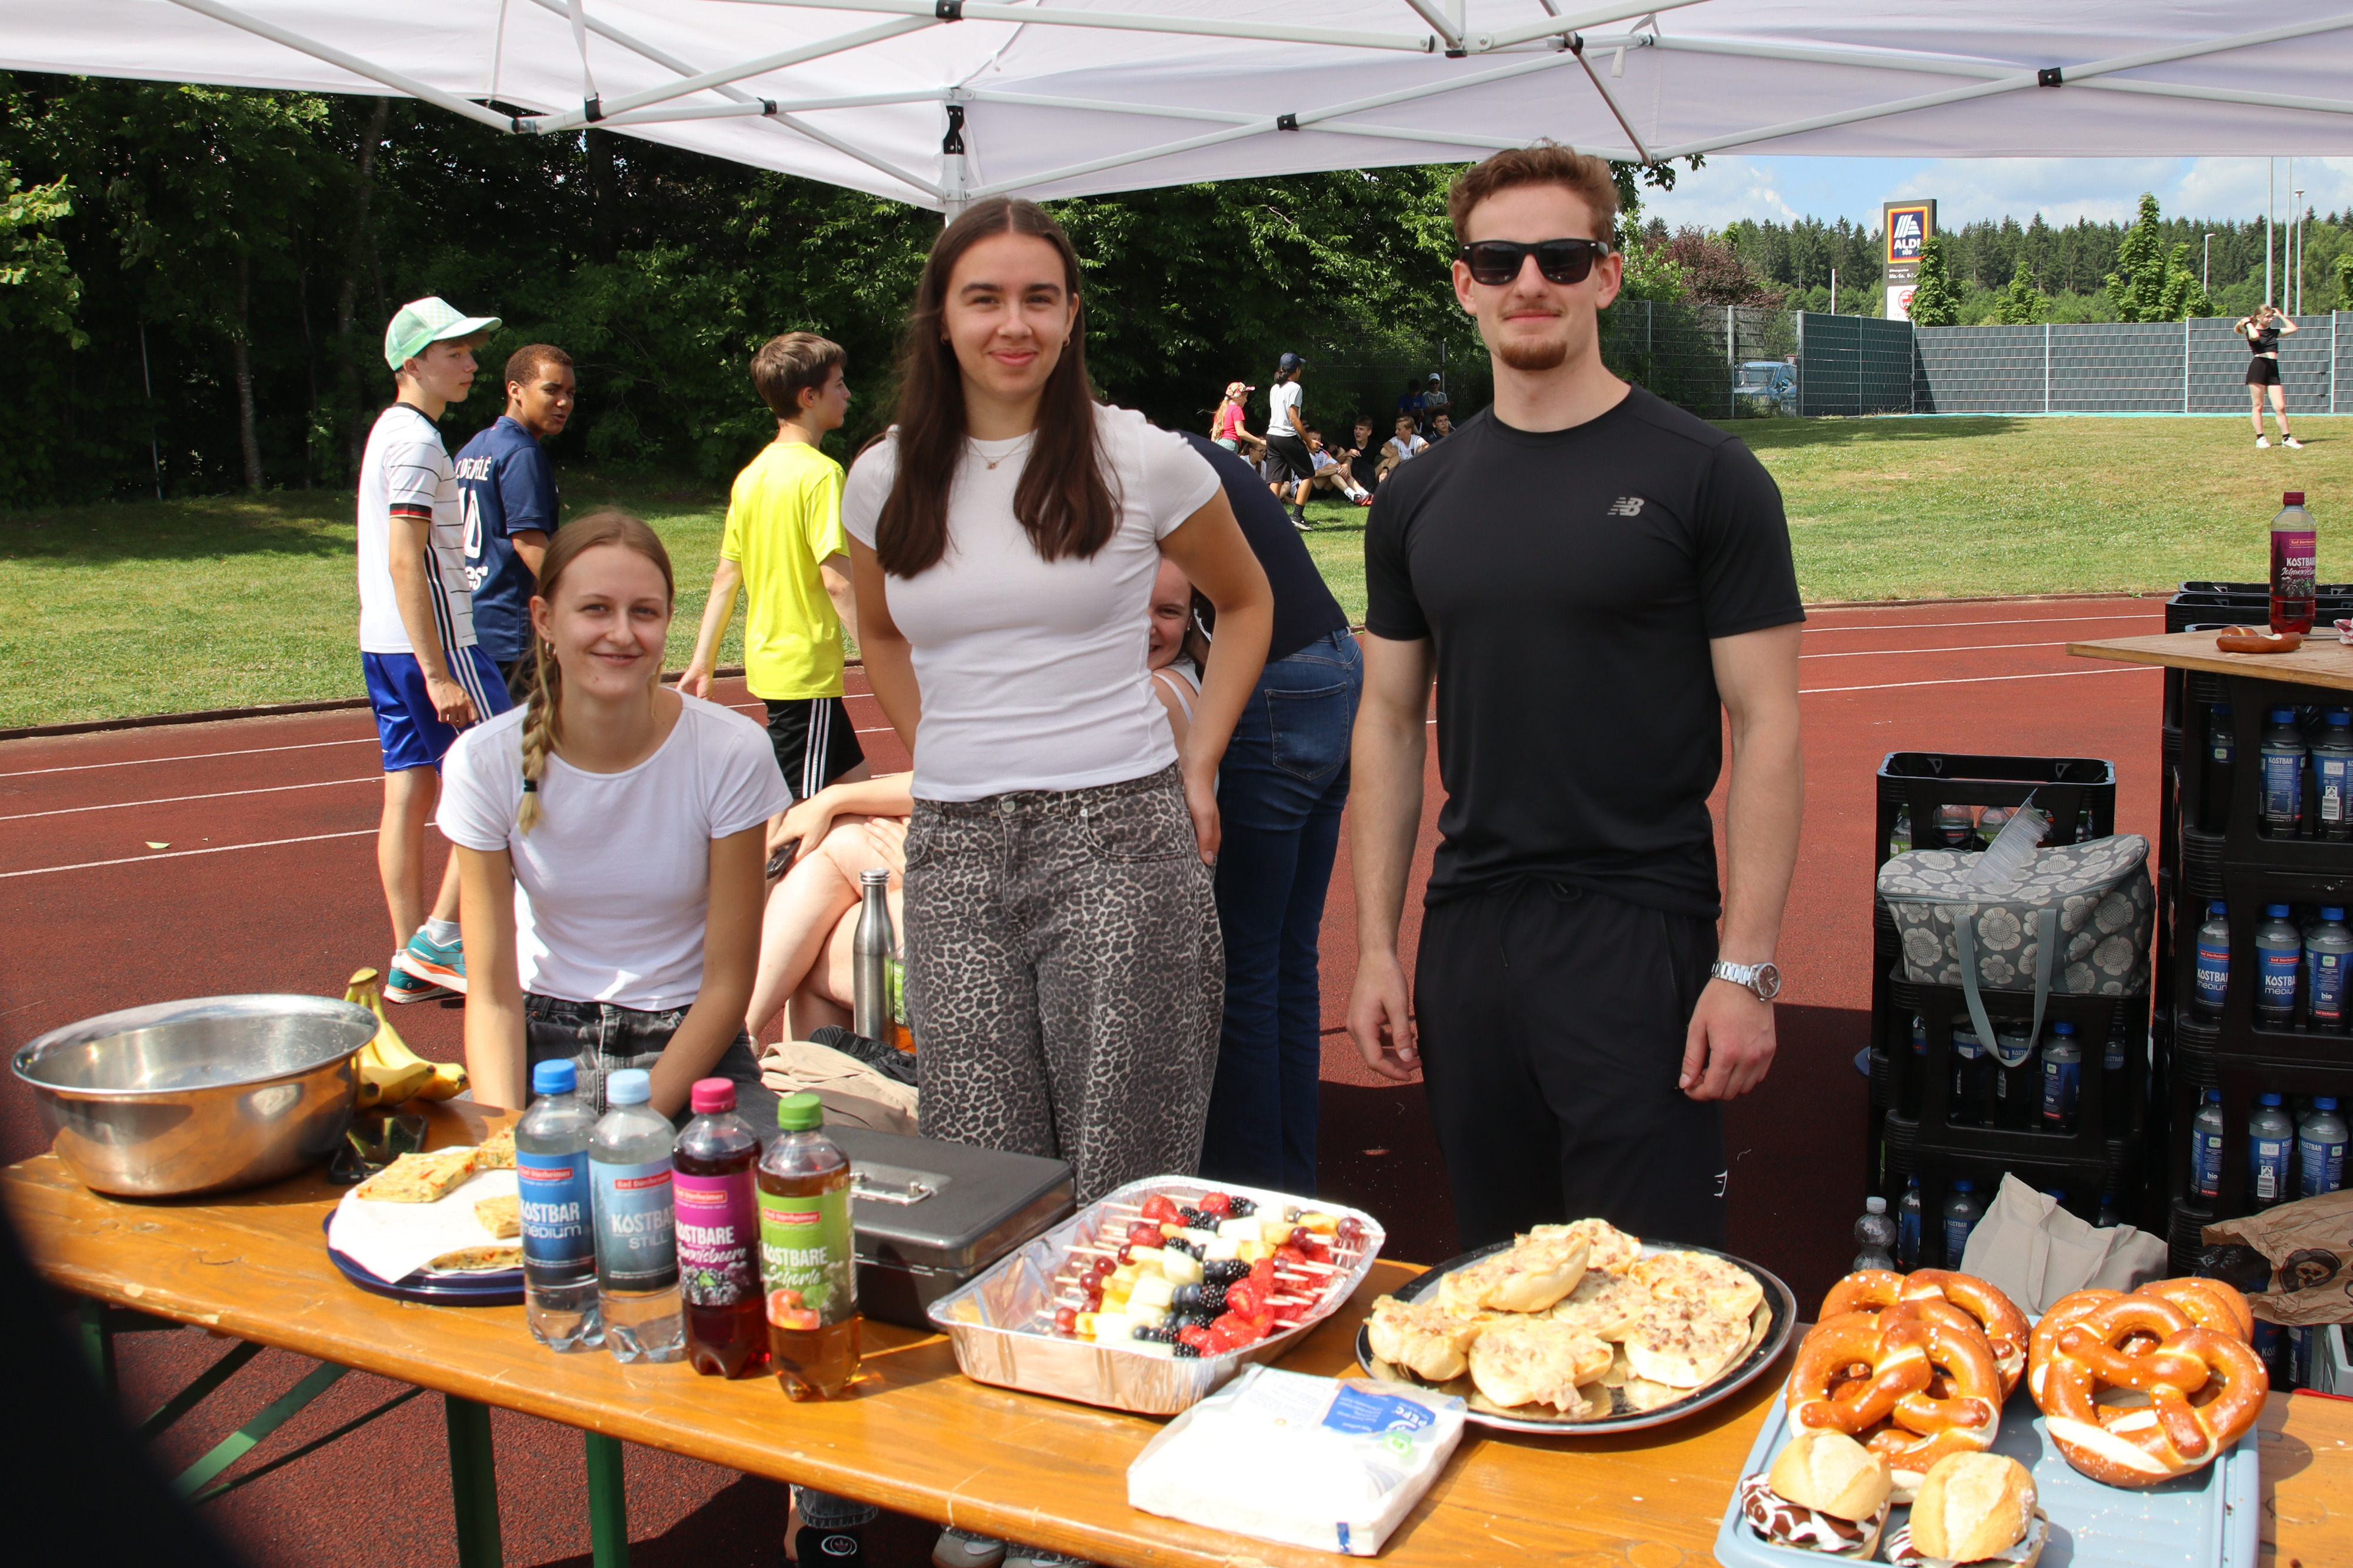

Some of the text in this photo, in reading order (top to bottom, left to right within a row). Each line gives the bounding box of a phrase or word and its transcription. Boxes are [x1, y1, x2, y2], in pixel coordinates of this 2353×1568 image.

[1894, 238, 1921, 249] ALDI
[2268, 756, 2293, 765] KOSTBAR
[2265, 975, 2296, 986] KOSTBA
[2301, 1140, 2322, 1152] KOSTBAR
[521, 1198, 581, 1224] KOSTBAR
[1947, 1220, 1967, 1228] KOSTBAR
[629, 1234, 668, 1250] STILL
[1395, 1406, 1428, 1428] PEFC
